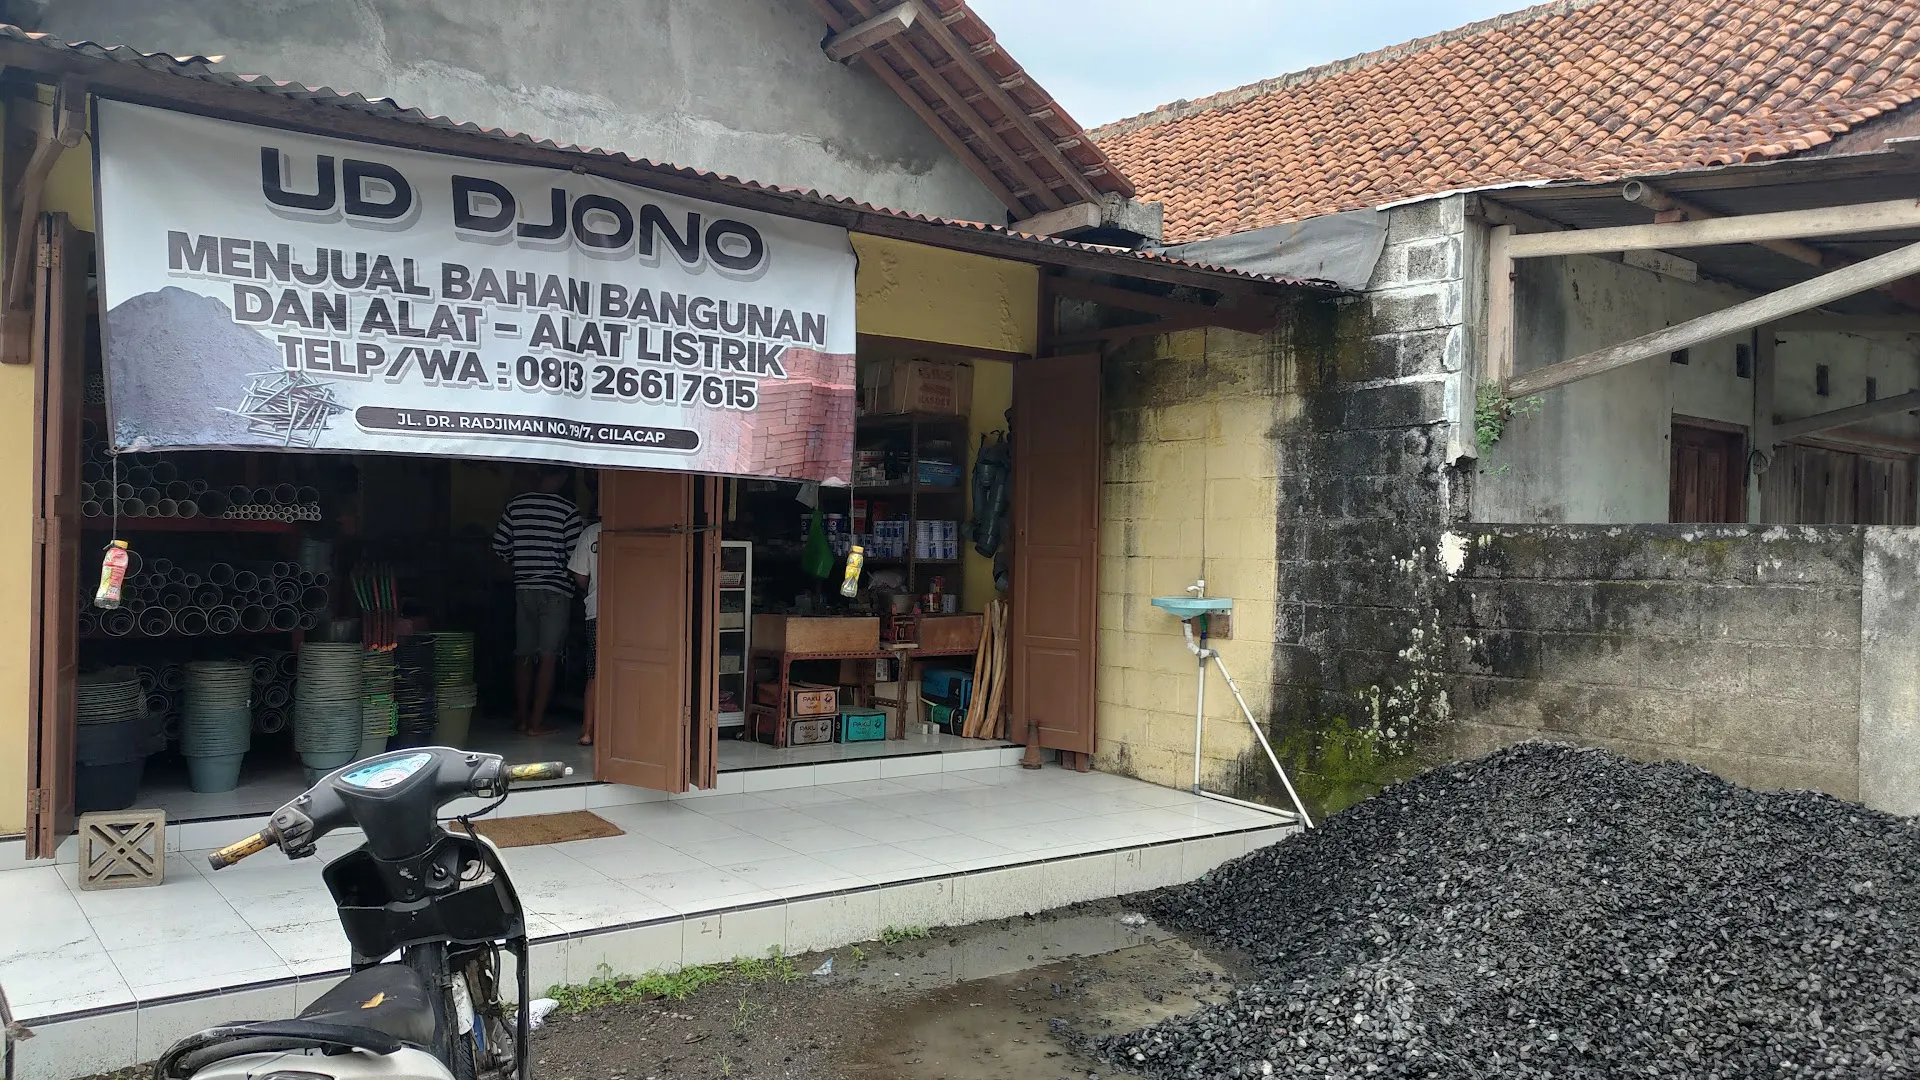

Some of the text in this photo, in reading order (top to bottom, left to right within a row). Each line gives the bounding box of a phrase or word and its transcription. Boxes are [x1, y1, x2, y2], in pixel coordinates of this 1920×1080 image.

[261, 146, 764, 271] UD DJONO
[167, 230, 826, 346] MENJUAL BAHAN BANGUNAN
[233, 284, 347, 332] DAN
[359, 297, 483, 343] ALAT
[528, 313, 628, 358] ALAT
[637, 327, 786, 377] LISTRIK
[277, 335, 489, 383] TELP/WA
[516, 355, 584, 392] 0813
[398, 412, 422, 427] JL.
[425, 414, 455, 428] DR.
[459, 416, 544, 434] RADJIMAN
[597, 428, 666, 443] CILACAP
[957, 715, 963, 723] 3
